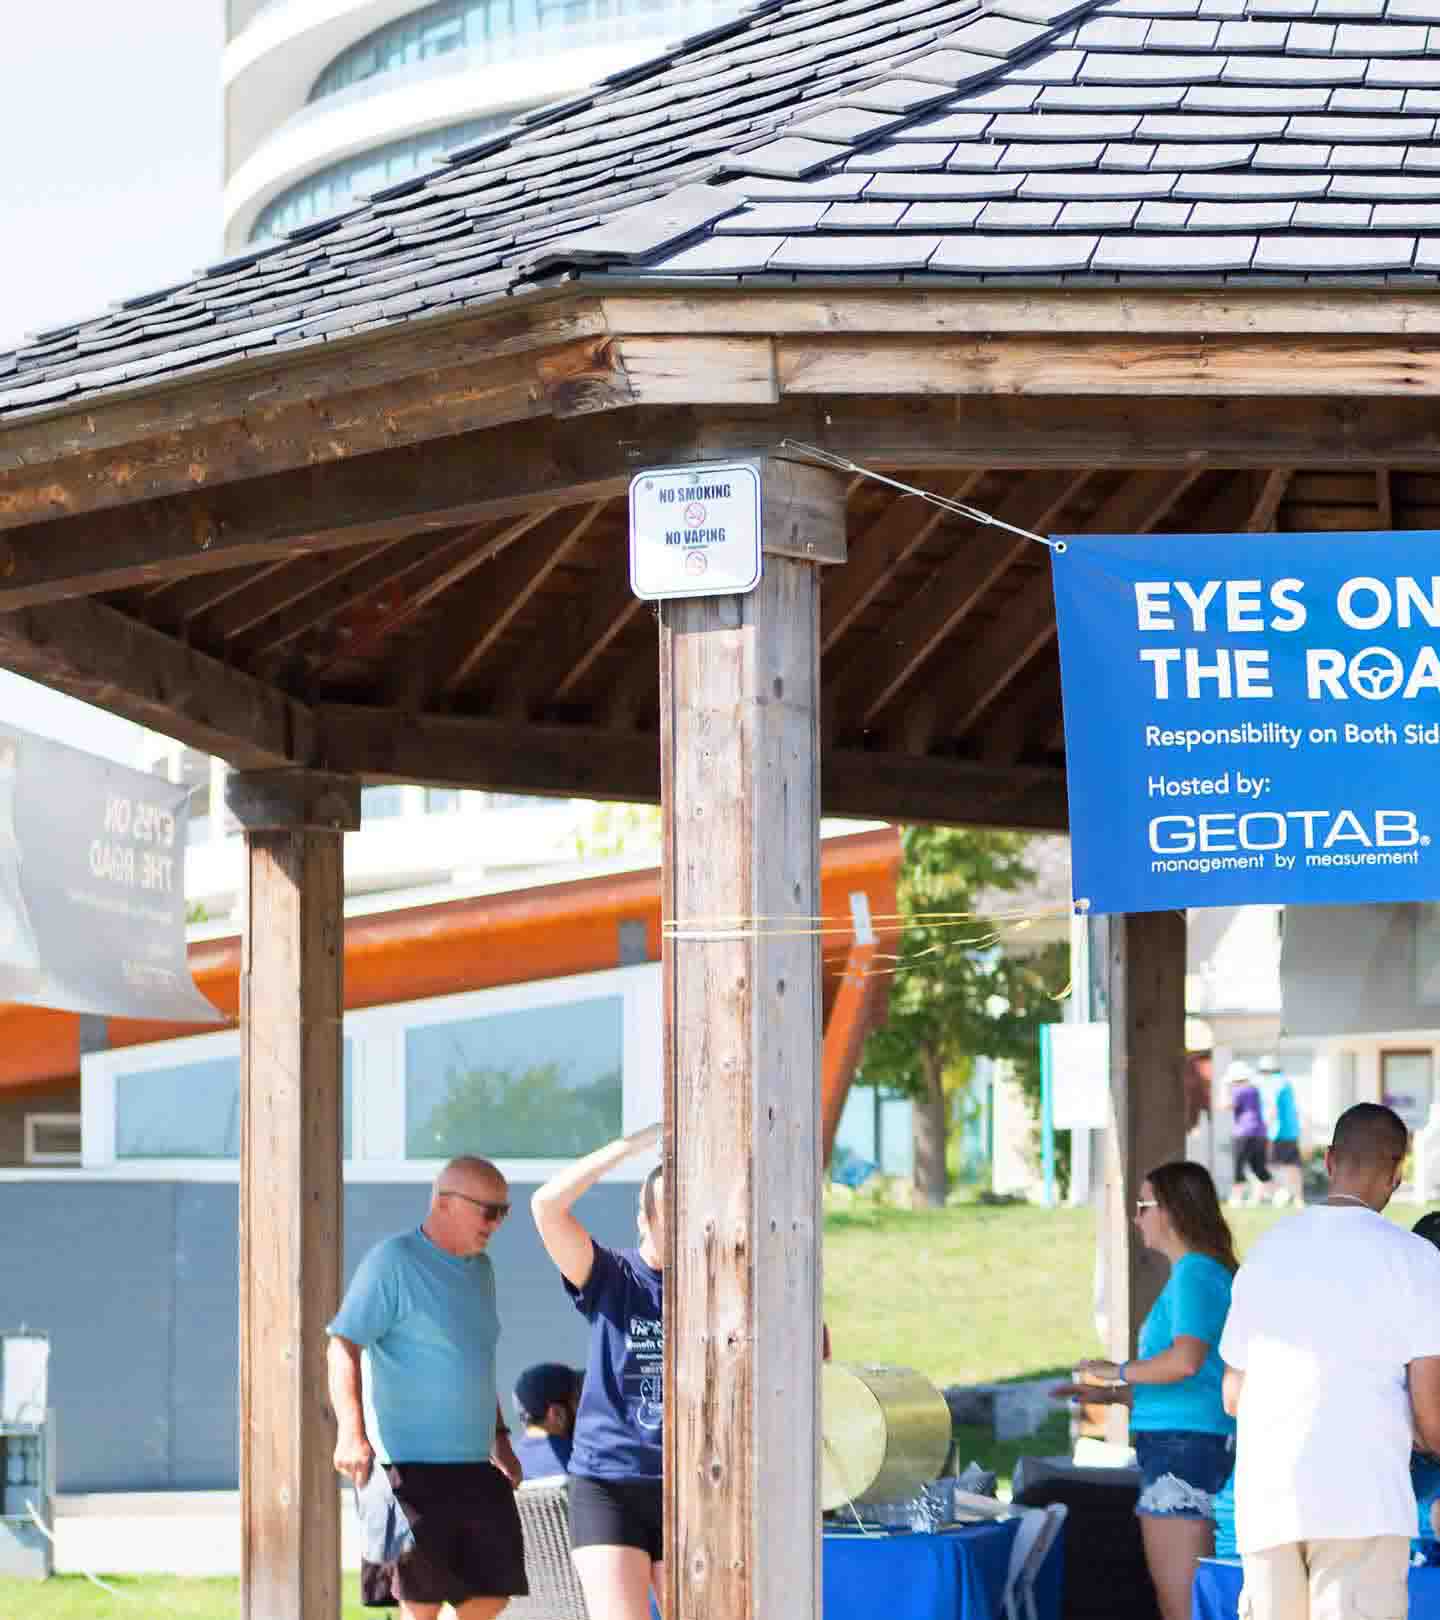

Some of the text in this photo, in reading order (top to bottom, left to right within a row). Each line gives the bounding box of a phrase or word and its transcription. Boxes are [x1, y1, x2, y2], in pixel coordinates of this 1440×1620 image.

[659, 484, 731, 503] NO SMOKING
[665, 528, 726, 545] NO VAPING
[1135, 579, 1307, 632] EYES
[1140, 648, 1273, 699] THE
[1146, 723, 1302, 752] Responsibility
[1309, 728, 1337, 743] on
[1345, 724, 1397, 744] Both
[1148, 771, 1270, 798] Hosted by:
[1151, 849, 1419, 872] management by measurement
